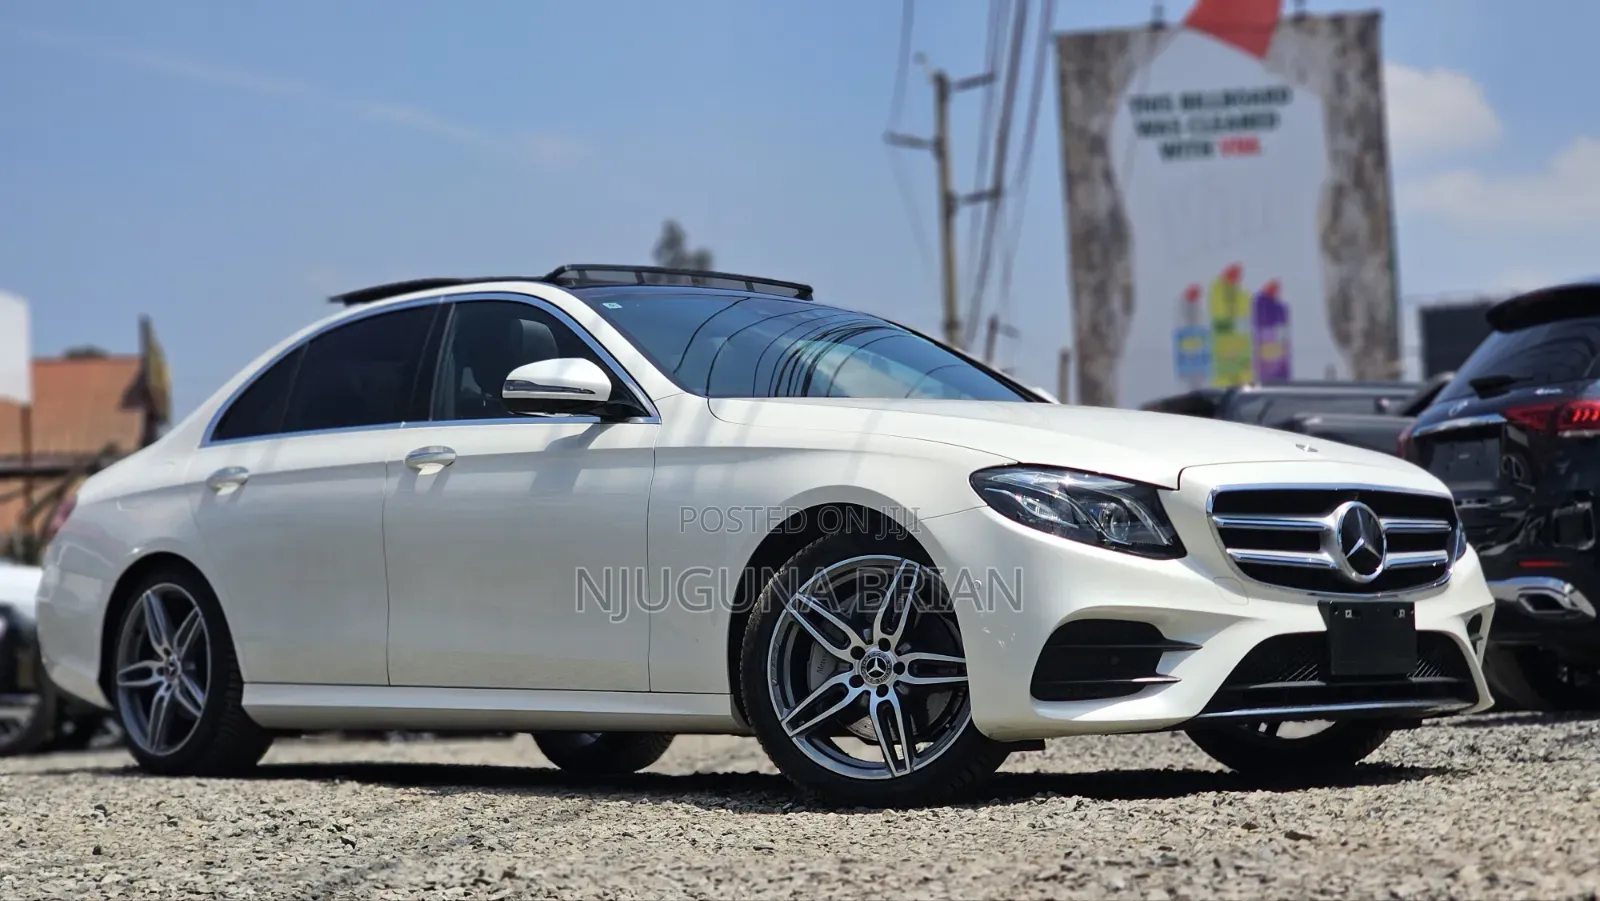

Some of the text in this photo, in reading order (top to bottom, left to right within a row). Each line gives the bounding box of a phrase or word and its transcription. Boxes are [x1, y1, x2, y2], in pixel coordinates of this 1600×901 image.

[1130, 87, 1292, 113] THIS BILLBOARD
[1136, 113, 1280, 138] WAS CLEANED
[1159, 142, 1214, 161] WITH
